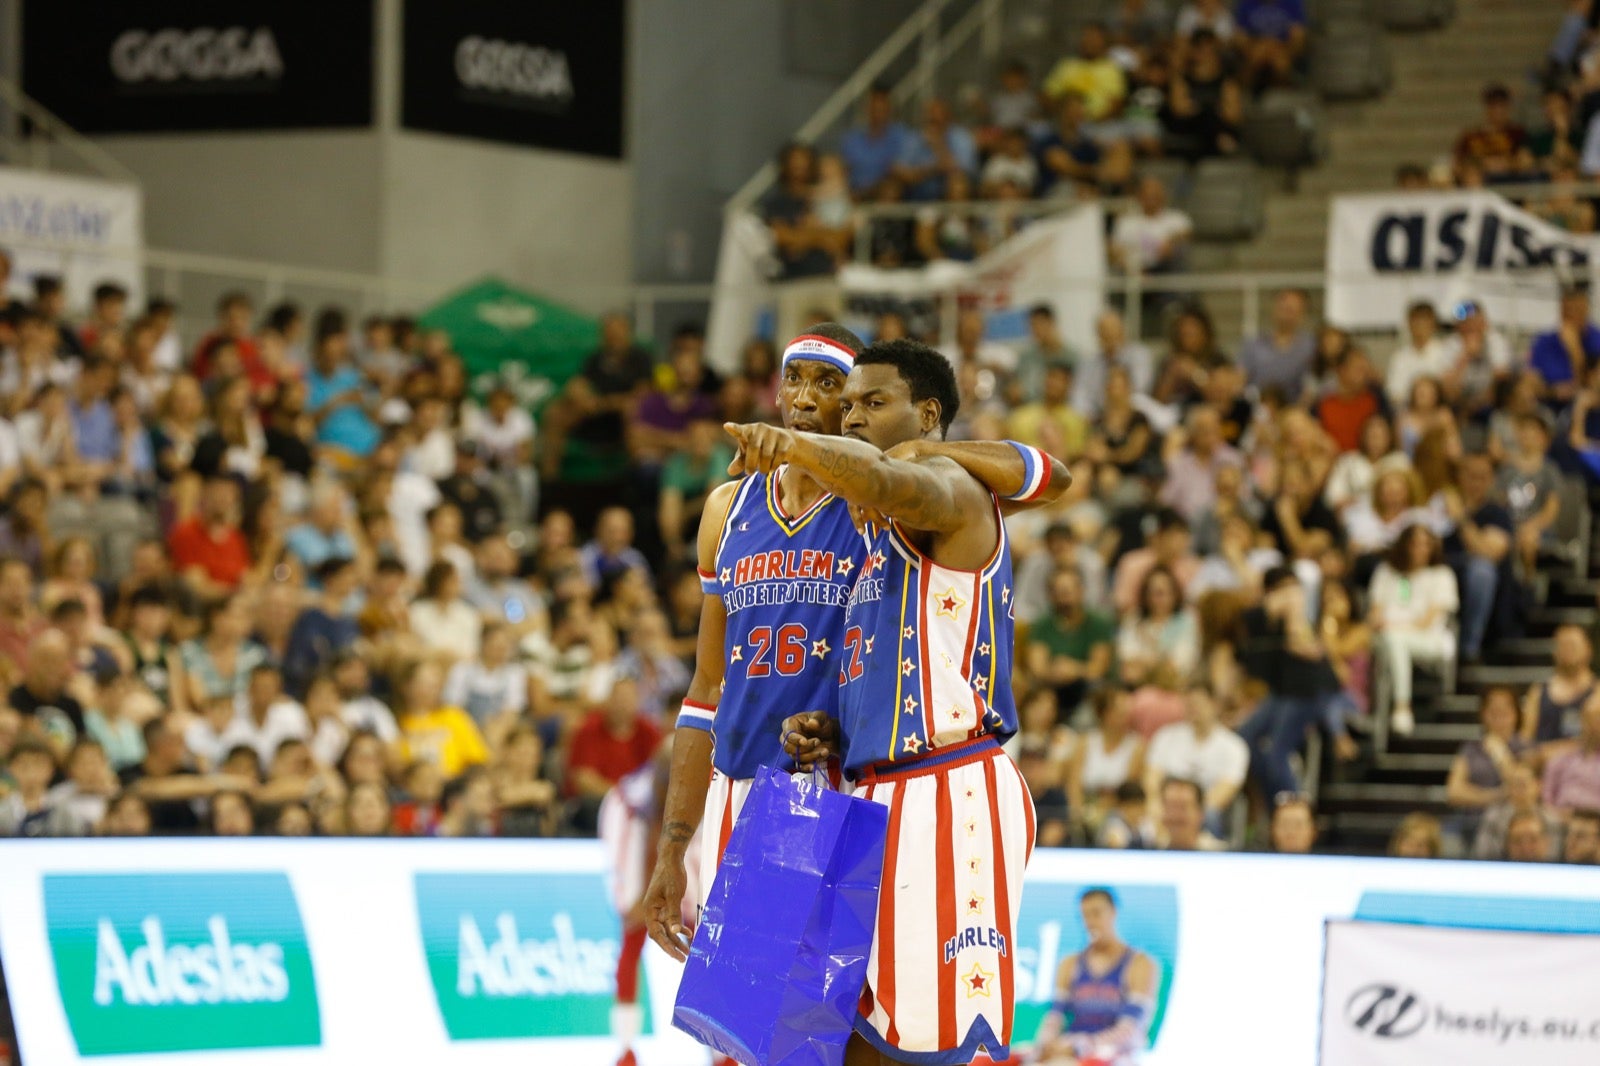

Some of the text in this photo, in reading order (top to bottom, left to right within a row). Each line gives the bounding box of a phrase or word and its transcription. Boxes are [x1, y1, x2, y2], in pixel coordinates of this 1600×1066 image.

[734, 549, 835, 587] HARLEM
[723, 580, 851, 616] GLOBETROTTERS
[746, 622, 809, 680] 26
[838, 624, 864, 688] 2
[93, 913, 290, 1006] Adeslas
[456, 910, 620, 998] Adeslas
[944, 925, 1007, 965] HARLEM
